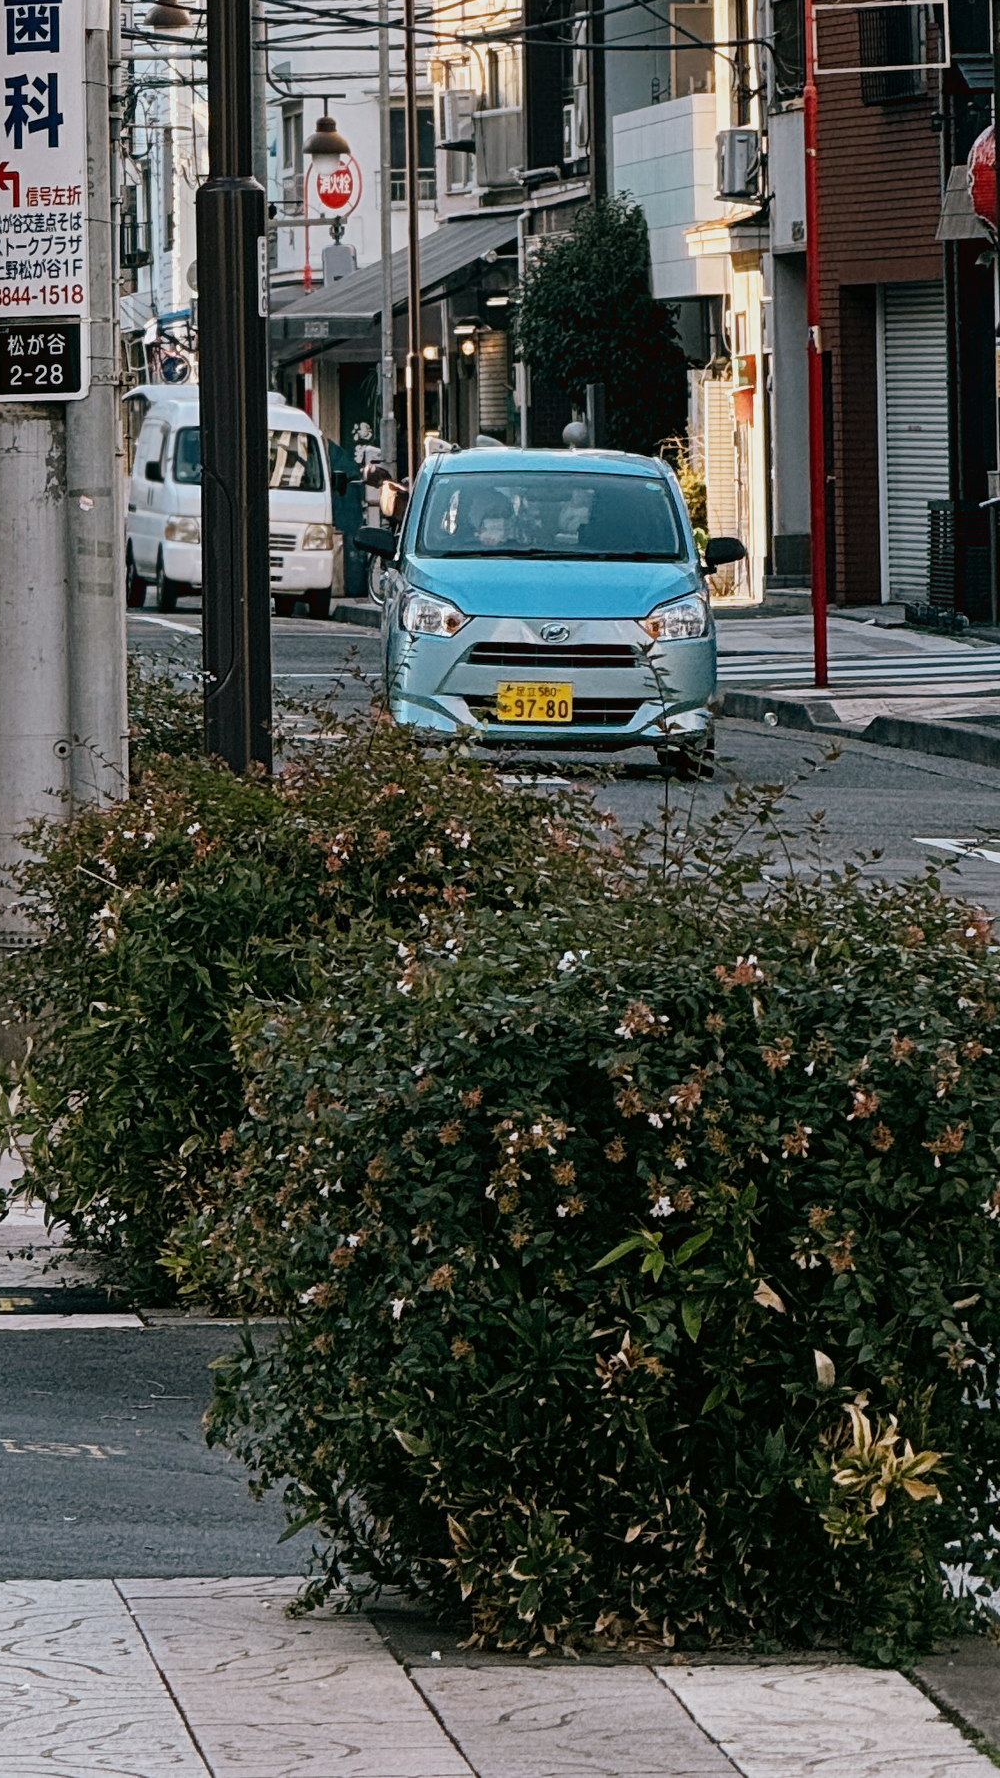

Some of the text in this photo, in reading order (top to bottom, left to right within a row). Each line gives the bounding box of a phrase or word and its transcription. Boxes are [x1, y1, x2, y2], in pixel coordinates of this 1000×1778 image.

[319, 172, 352, 195] 消火栓
[25, 185, 82, 208] 信号左折
[7, 332, 67, 358] 松が谷
[9, 363, 65, 387] 2-28
[514, 698, 569, 719] 97-80
